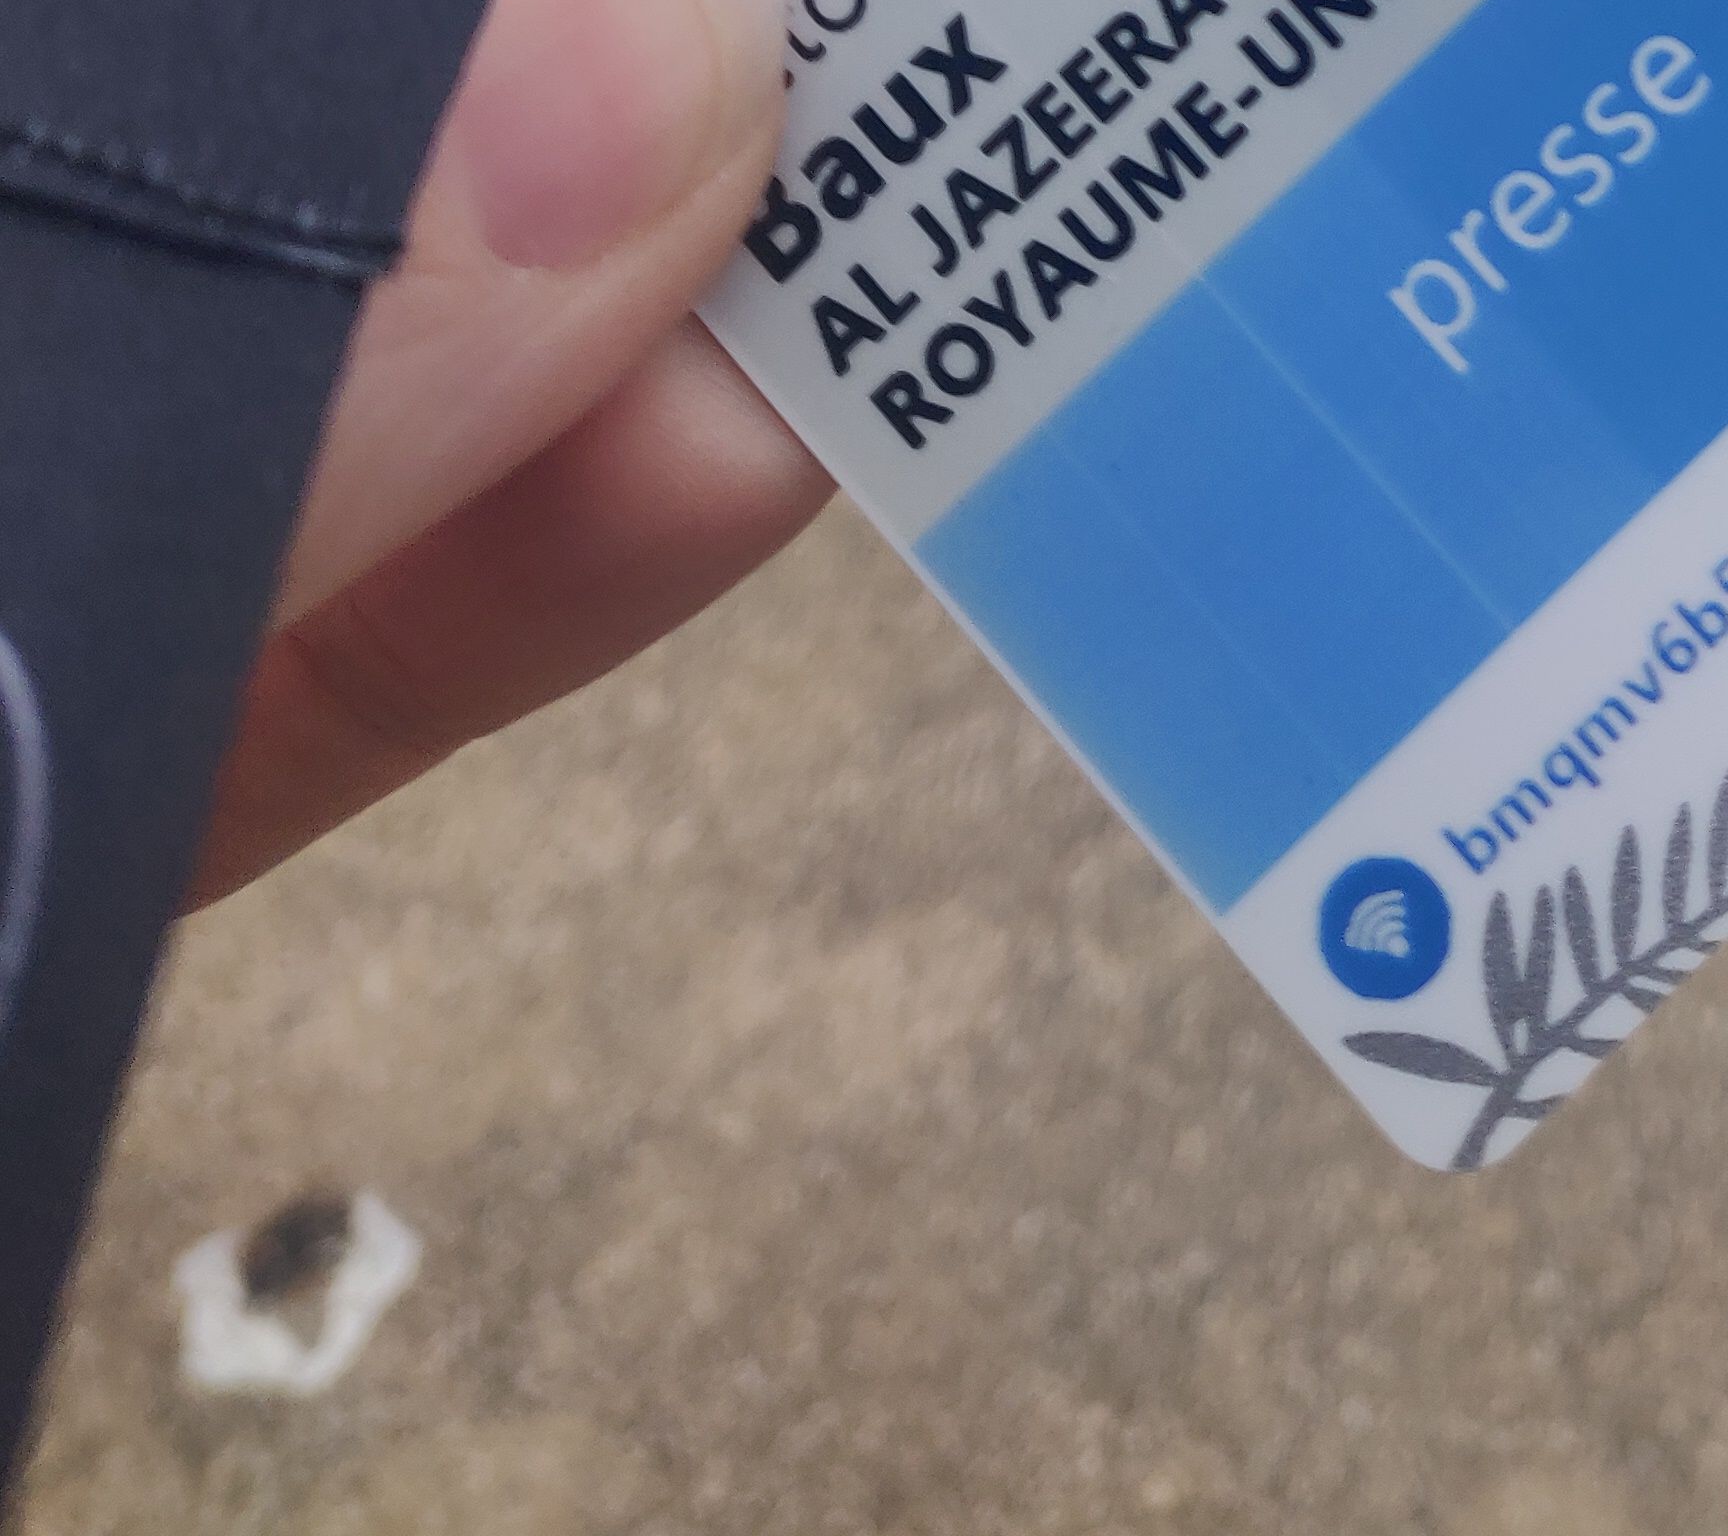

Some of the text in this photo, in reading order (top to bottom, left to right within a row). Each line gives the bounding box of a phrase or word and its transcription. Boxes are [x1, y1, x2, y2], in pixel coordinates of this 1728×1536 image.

[742, 11, 1008, 286] Baux
[1384, 32, 1713, 375] presse
[806, 263, 921, 377] AL
